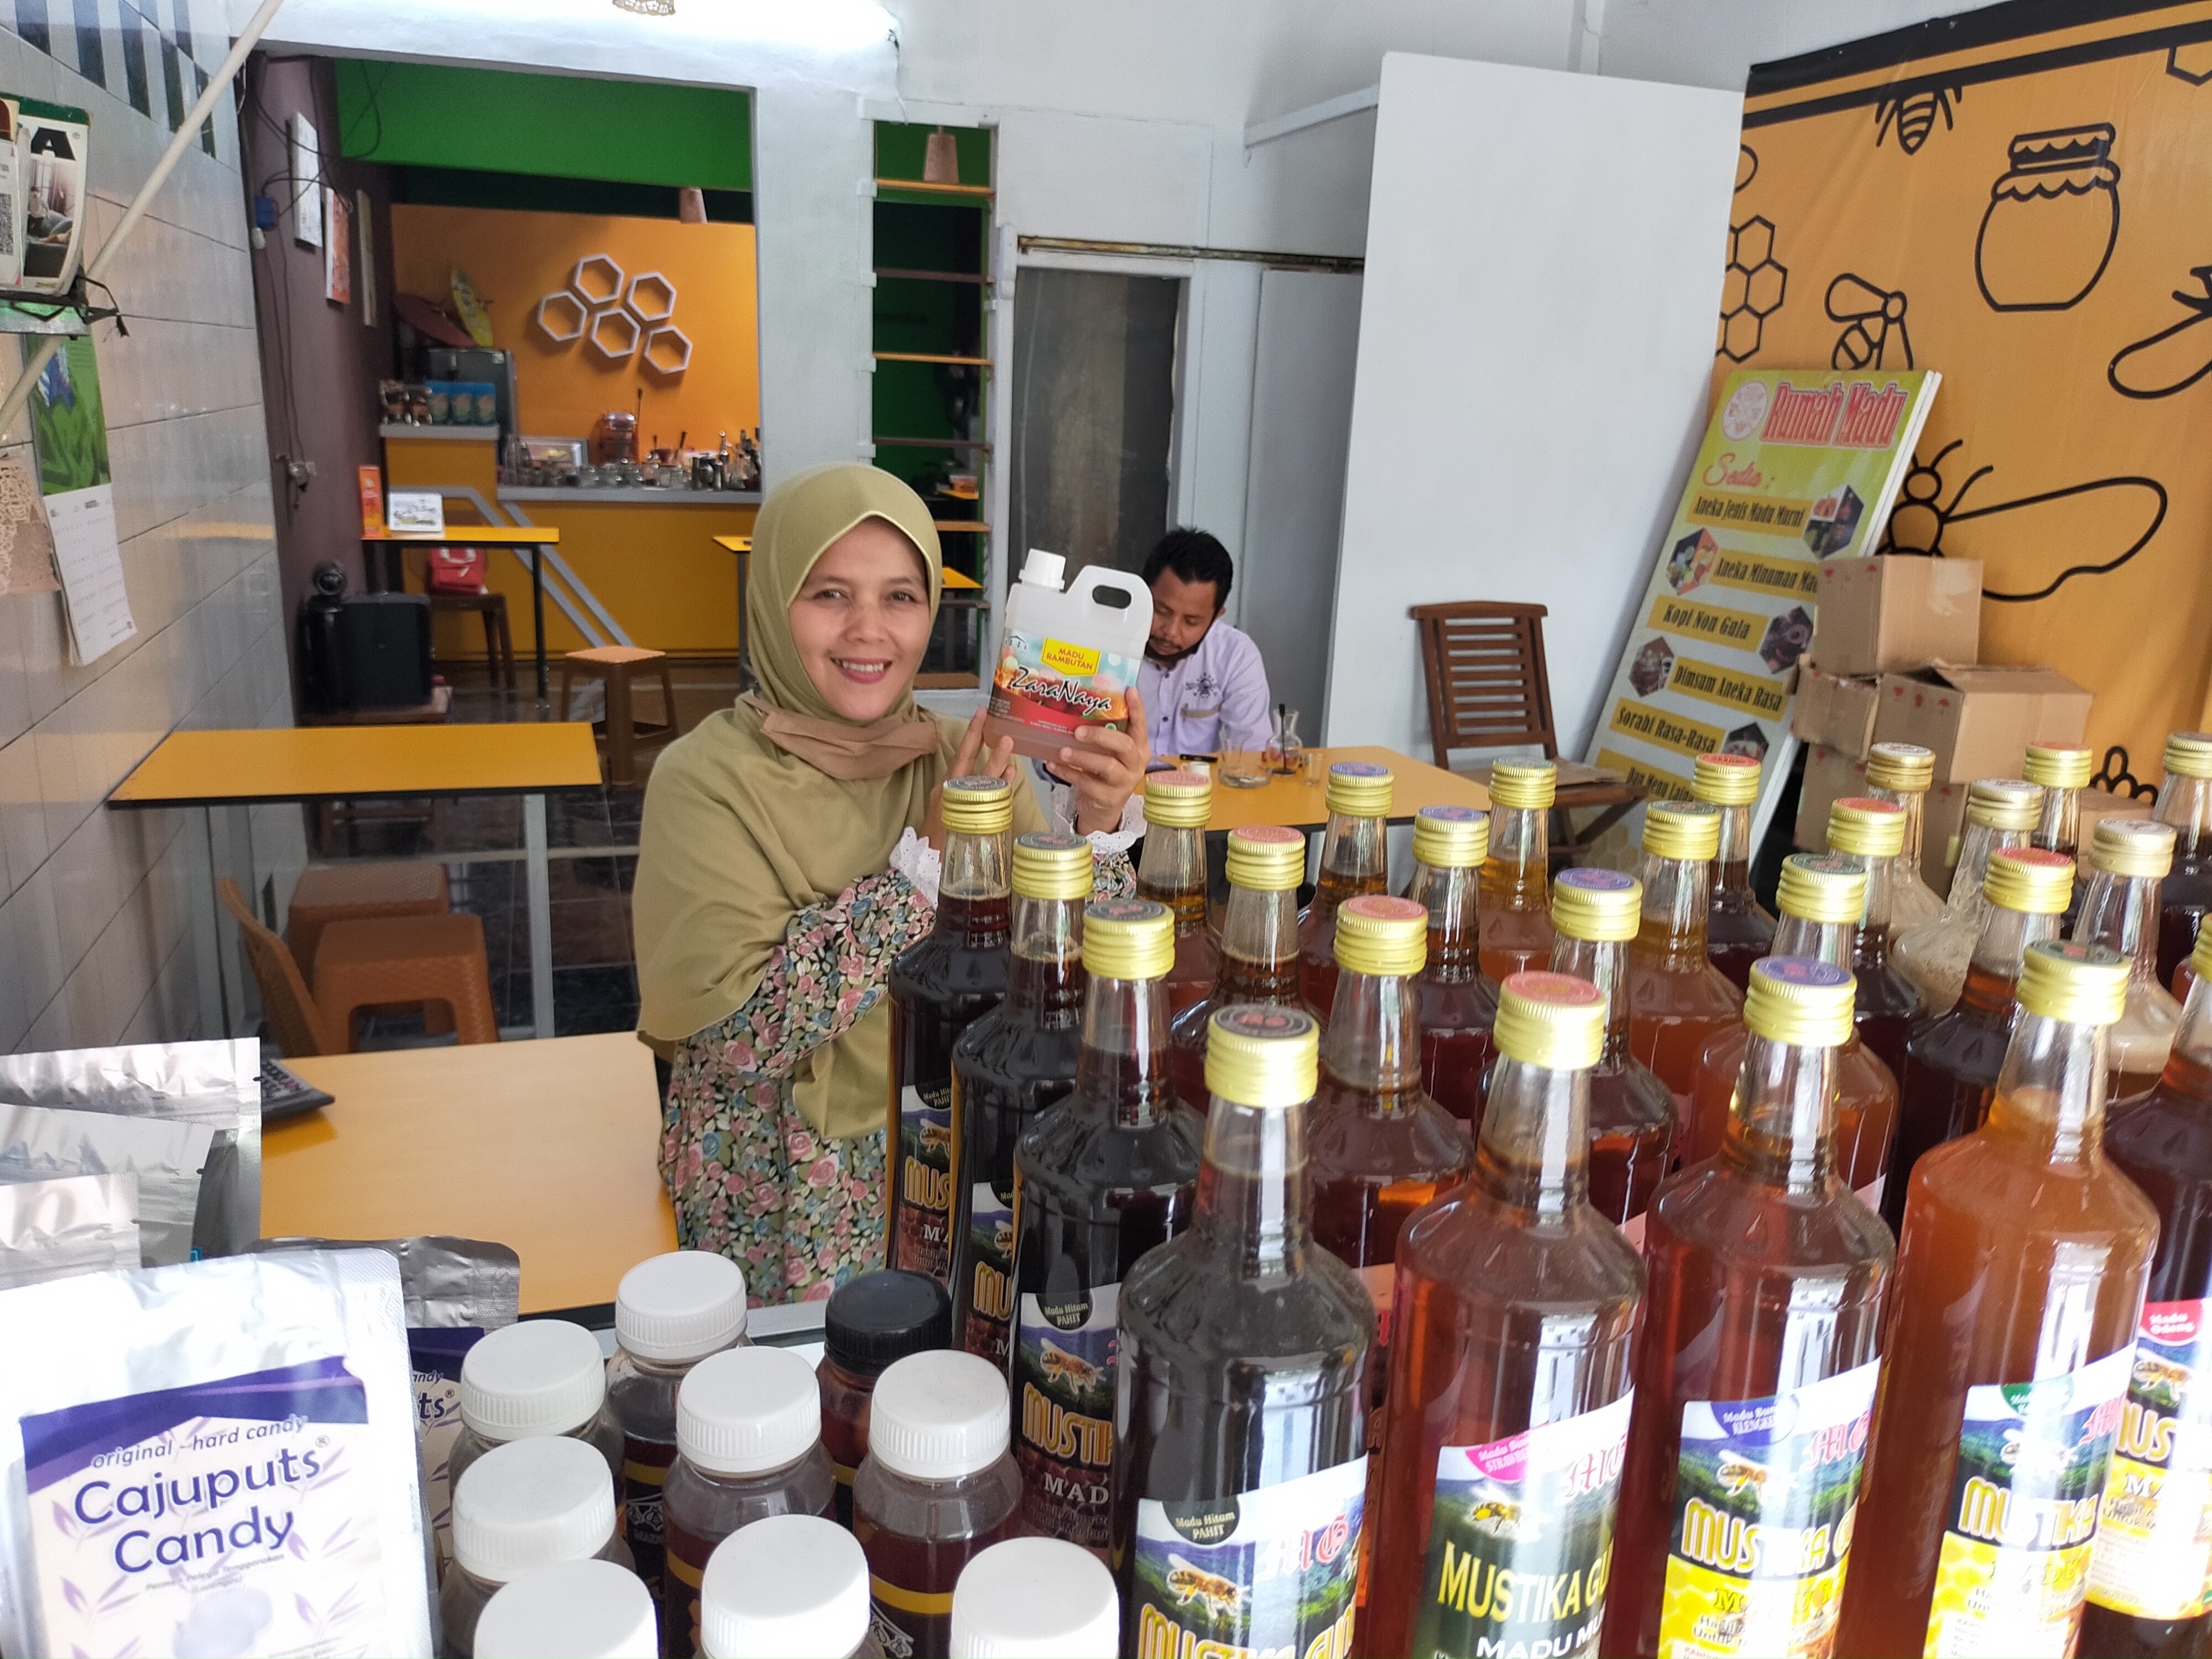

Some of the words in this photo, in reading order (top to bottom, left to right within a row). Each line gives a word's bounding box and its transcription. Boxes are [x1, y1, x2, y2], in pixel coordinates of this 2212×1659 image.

[1760, 382, 1843, 445] Rumah
[1832, 382, 1908, 449] Madu
[1702, 452, 1762, 488] Sedia
[1693, 496, 1724, 517] Aneka
[1722, 499, 1749, 521] Jenis
[1750, 502, 1776, 523] Madu
[1776, 505, 1806, 528] Murni
[1716, 557, 1749, 581] Aneka
[1751, 562, 1798, 589] Minuman
[1663, 603, 1693, 629] Kopi
[1693, 608, 1718, 633] Non
[1719, 615, 1751, 640] Gula
[1046, 653, 1093, 671] RAMBUTAN
[1058, 648, 1085, 660] MADU
[1673, 665, 1717, 695] Dimsum
[1717, 677, 1752, 704] Aneka
[1752, 683, 1782, 712] Rasa
[1655, 718, 1717, 753] Rasa-Rasa
[923, 1090, 940, 1100] Madu
[940, 1087, 951, 1097] Hit
[1044, 1306, 1064, 1316] Madu
[1065, 1302, 1089, 1313] Hitam
[1056, 1313, 1081, 1326] PAHIT
[91, 1441, 173, 1469] original
[192, 1426, 240, 1451] hard
[246, 1413, 308, 1441] candy
[1044, 1471, 1109, 1505] MAD
[1175, 1514, 1203, 1528] Madu
[1203, 1511, 1236, 1525] Hitam
[1192, 1524, 1225, 1540] PAHIT
[114, 1505, 294, 1573] Candy
[1437, 1540, 1580, 1623] MUSTIKA
